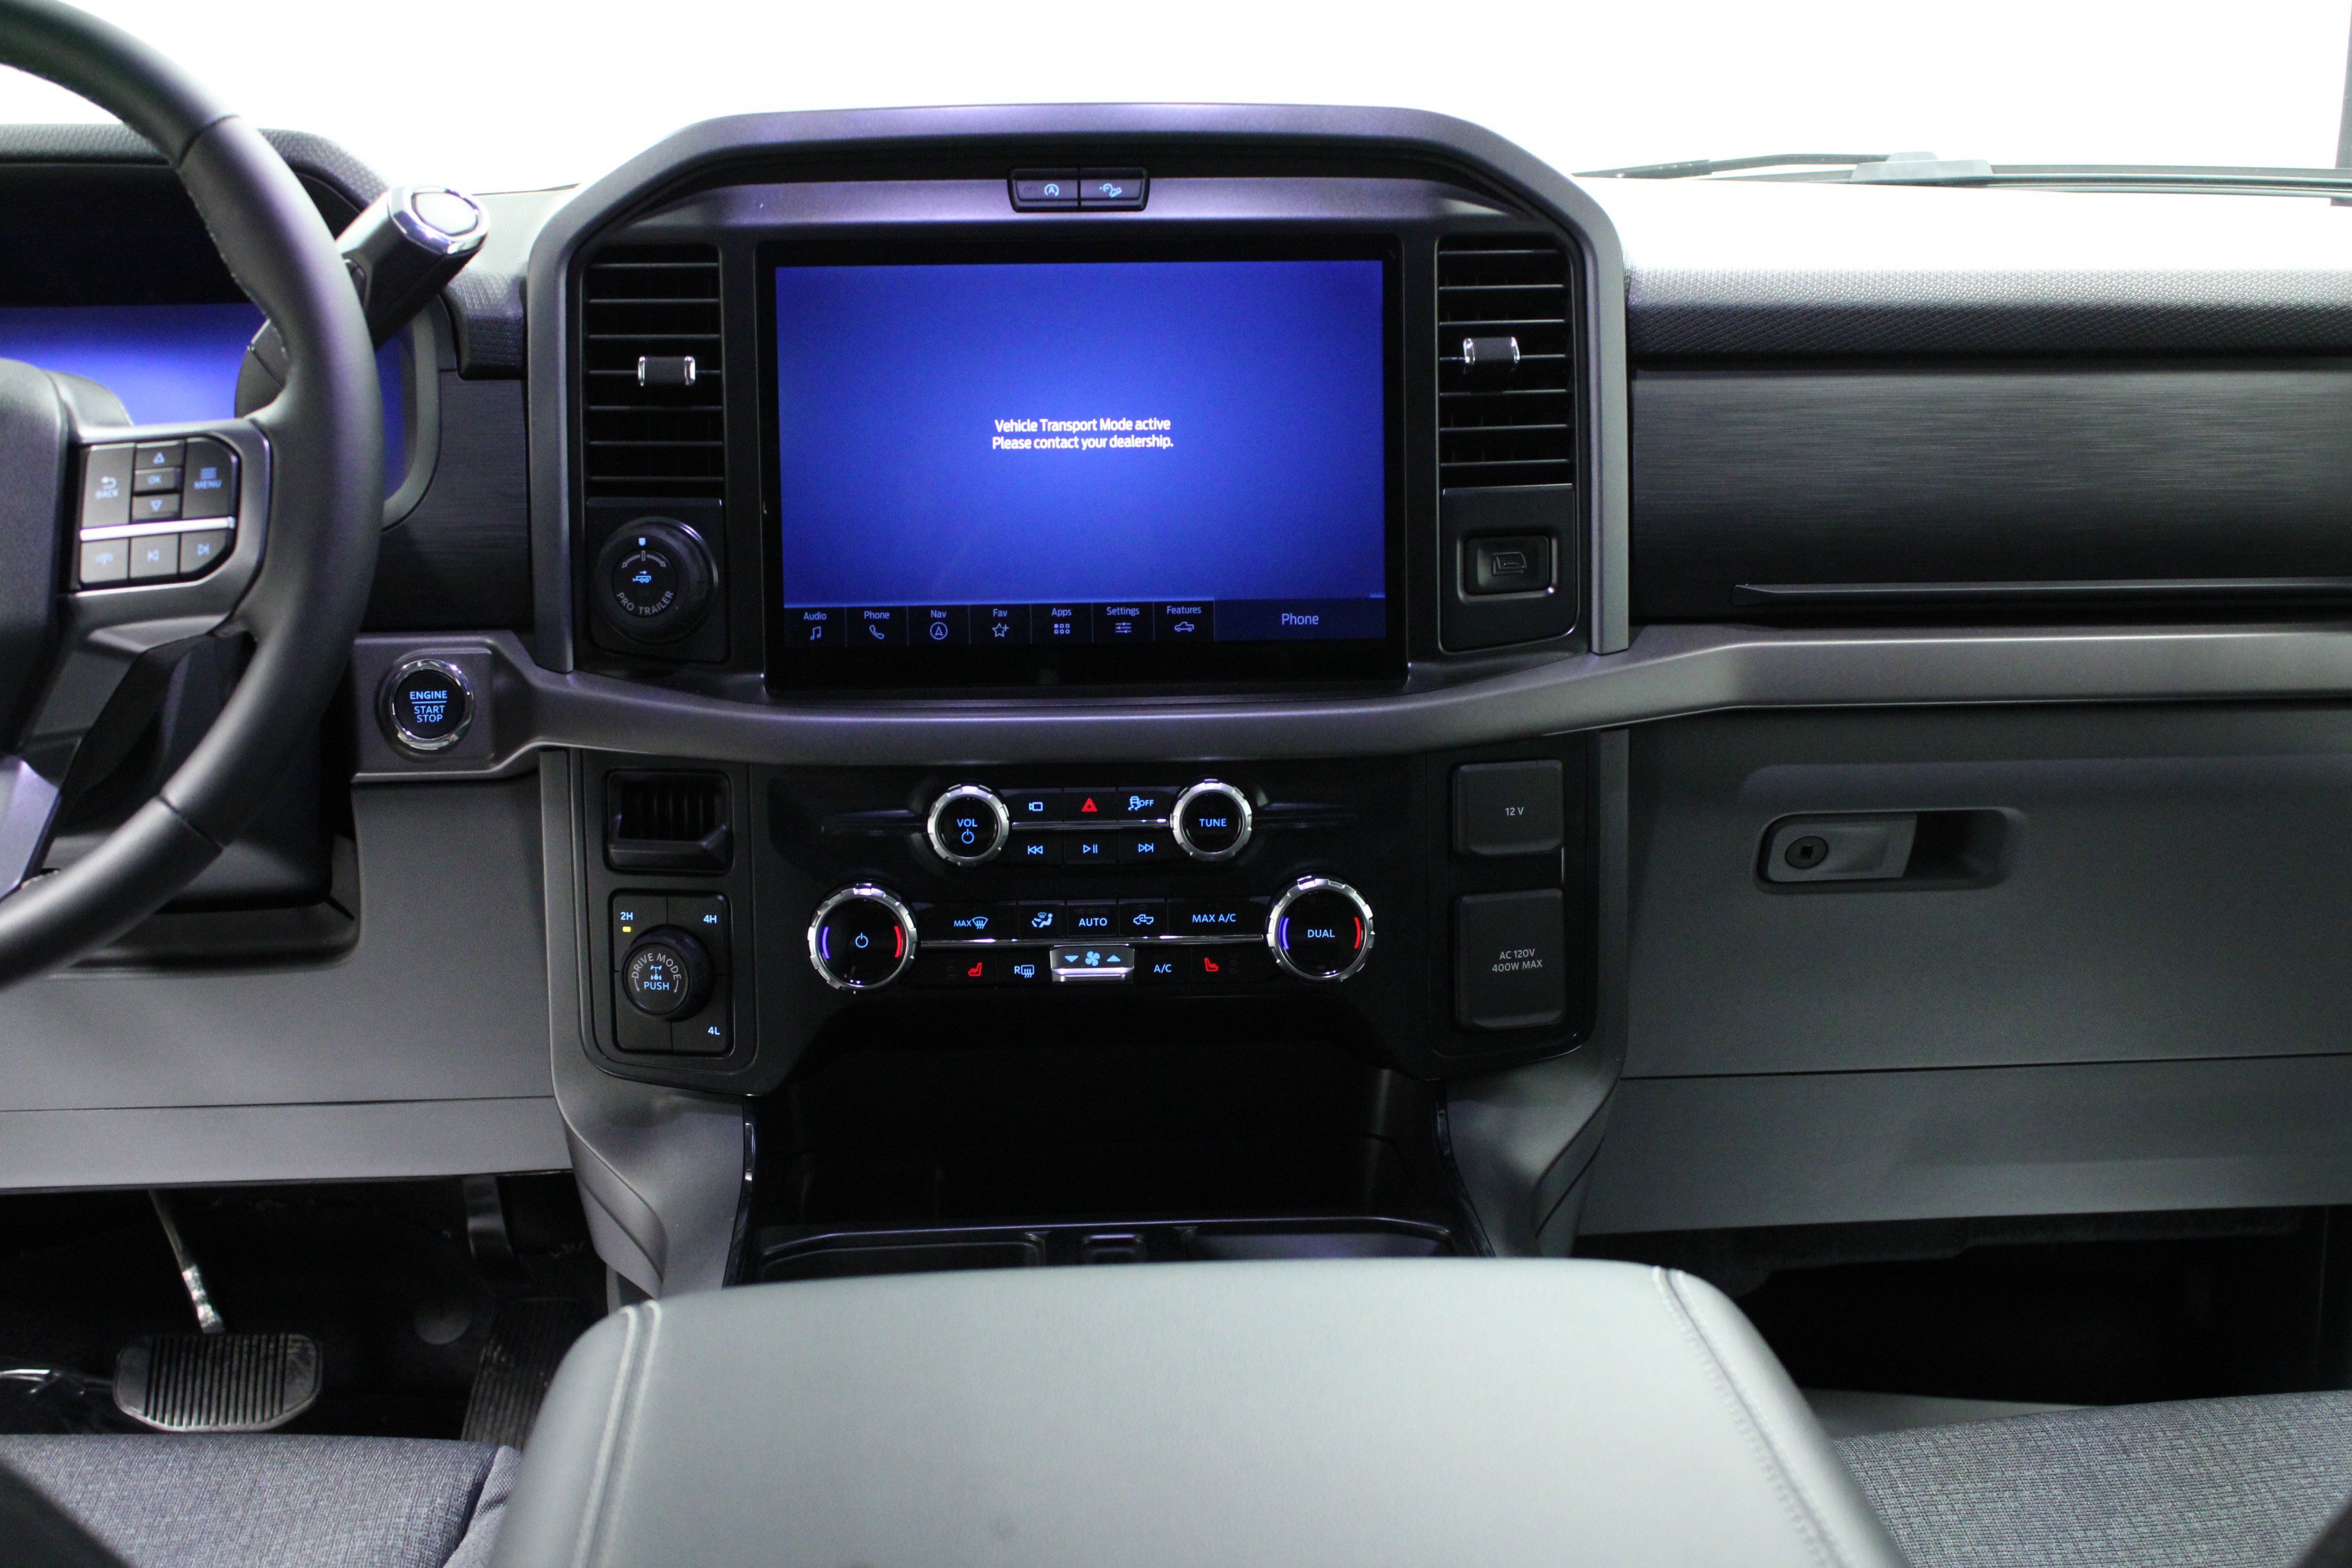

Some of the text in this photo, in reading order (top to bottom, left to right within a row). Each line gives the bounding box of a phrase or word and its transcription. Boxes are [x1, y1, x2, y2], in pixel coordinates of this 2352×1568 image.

[994, 417, 1171, 433] Vehicle Transport Mode active
[992, 435, 1174, 450] Please contact your dealership.
[148, 475, 162, 485] OK
[193, 479, 222, 490] MENU
[95, 489, 119, 499] BACK
[616, 590, 674, 615] PRO TRAILER
[864, 610, 890, 619] Phone
[930, 609, 947, 618] Nav
[992, 609, 1008, 617] Fav
[1051, 607, 1072, 618] Apps
[1106, 606, 1140, 616] Settings
[1167, 605, 1201, 615] Features
[803, 611, 827, 620] Audio
[1281, 613, 1319, 625] Phone
[409, 690, 448, 700] ENGINE
[414, 705, 445, 714] START
[417, 714, 443, 723] STOP
[1504, 806, 1524, 816] 12 V
[956, 818, 978, 827] VOL
[1199, 818, 1227, 827] TUNE
[620, 912, 633, 920] 2H
[703, 914, 717, 923] 4H
[1192, 913, 1236, 923] MAX A/C
[1078, 917, 1108, 927] AUTO
[1307, 929, 1335, 938] DUAL
[1499, 948, 1536, 960] AC 120V
[631, 952, 681, 981] DRIVE MODE
[1154, 963, 1172, 973] A/C
[1492, 959, 1543, 973] 400W MAX
[643, 981, 669, 991] PUSH
[708, 1026, 720, 1035] 4L
